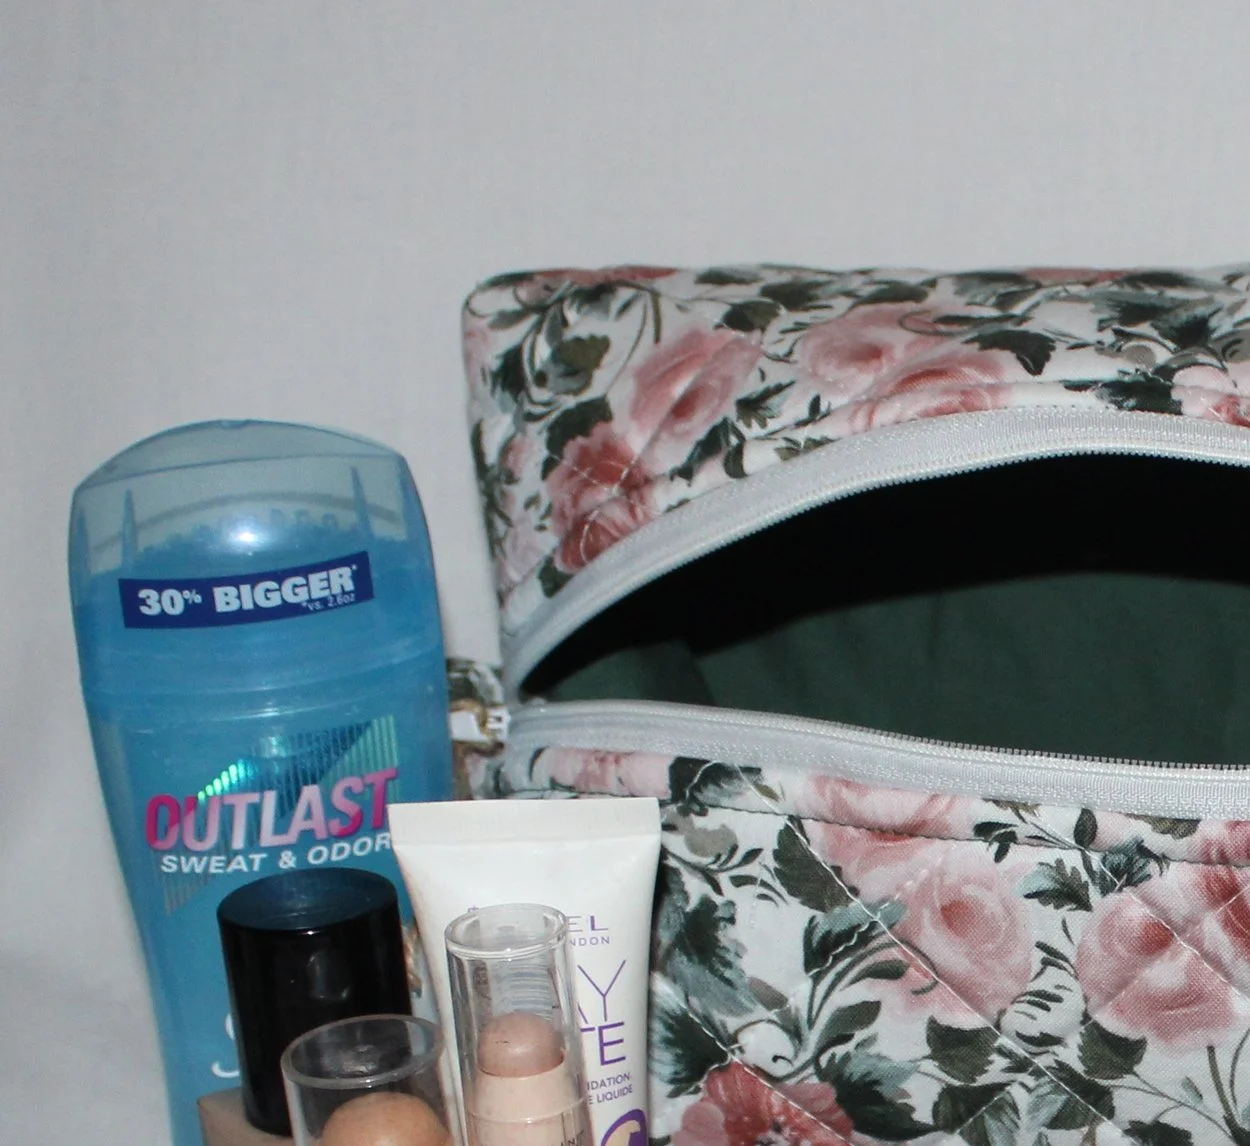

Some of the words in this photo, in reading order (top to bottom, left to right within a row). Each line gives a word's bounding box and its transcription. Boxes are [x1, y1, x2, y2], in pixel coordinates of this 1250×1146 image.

[138, 588, 202, 616] 30%
[145, 767, 398, 851] OUTLAST
[160, 854, 267, 873] SWEAT
[279, 850, 297, 869] &
[307, 842, 392, 865] ODOR
[588, 1072, 632, 1091] DATION
